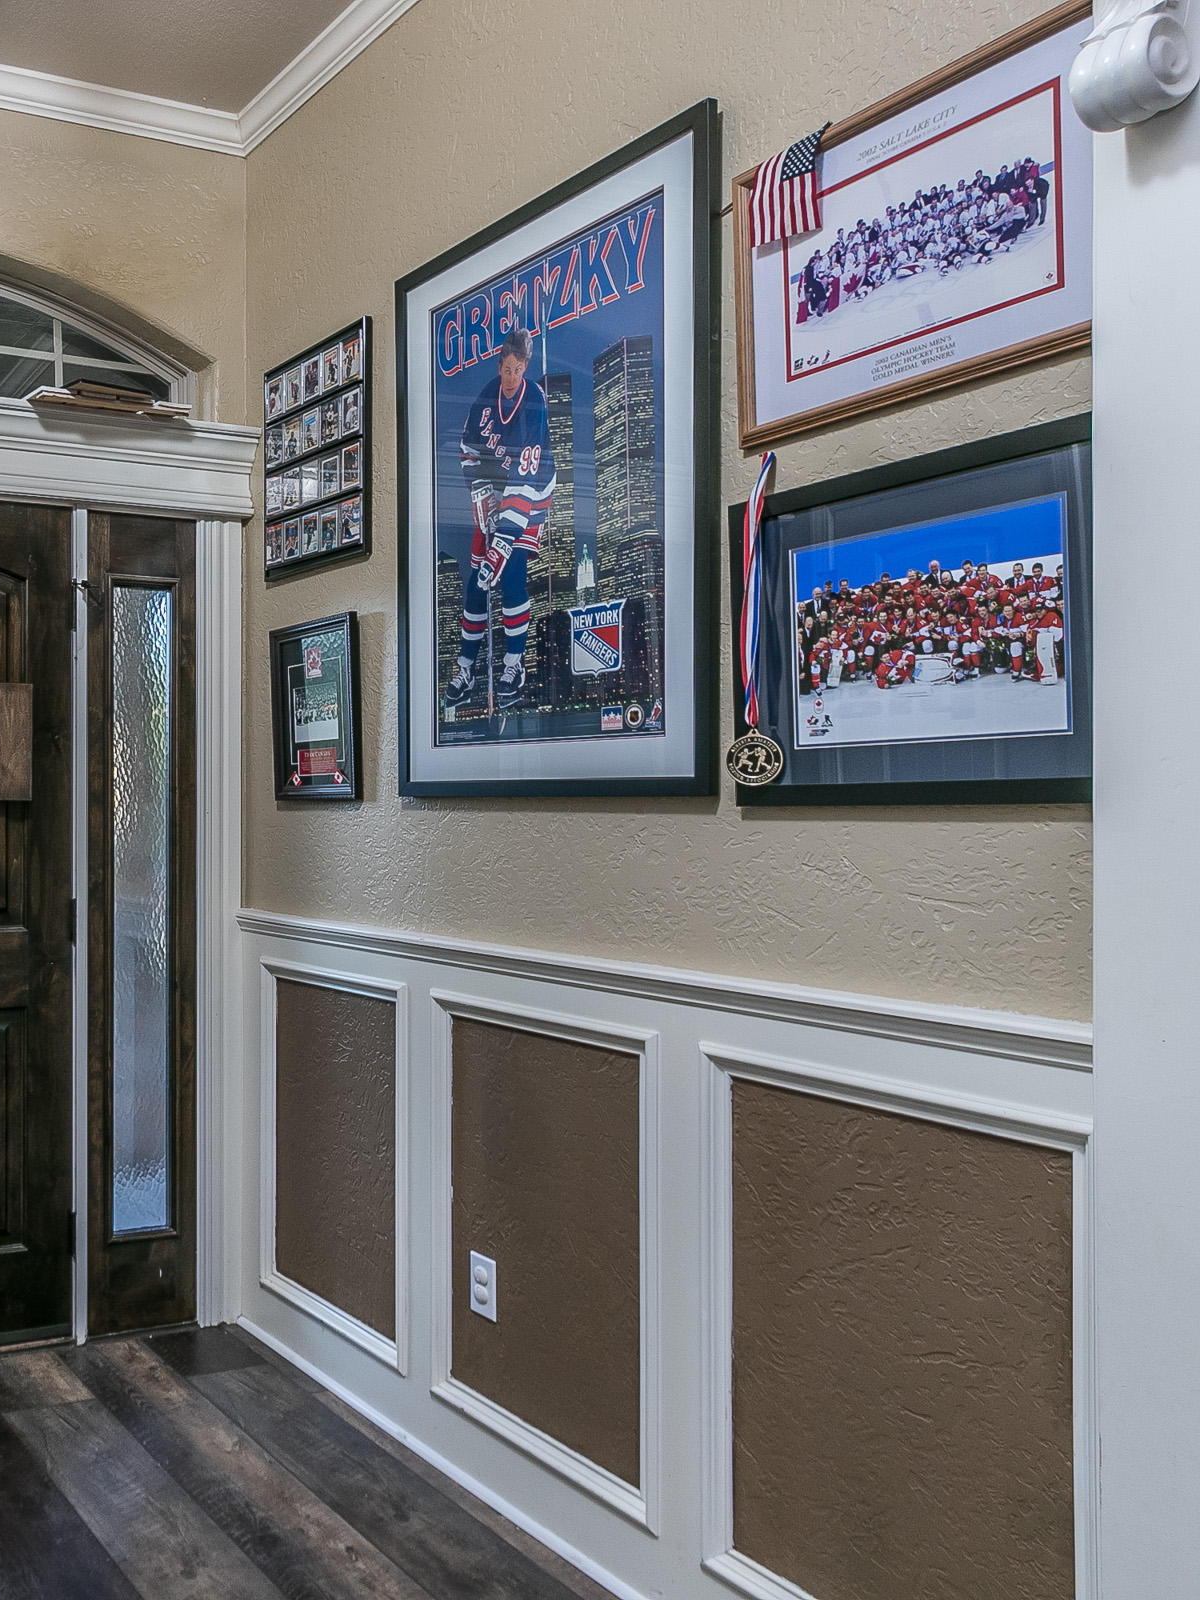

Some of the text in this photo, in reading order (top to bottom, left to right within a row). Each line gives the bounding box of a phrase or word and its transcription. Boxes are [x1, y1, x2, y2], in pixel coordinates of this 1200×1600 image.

[857, 104, 958, 161] 2002 SALT LAKE CITY
[438, 204, 656, 377] GRETZKY
[871, 342, 956, 375] OLYMPIC HOCKEY TEAM
[872, 350, 955, 382] GOLD MEDAL WINNERS
[875, 335, 953, 366] 2002 CANADIAN MEN'S
[518, 444, 541, 476] 99
[574, 609, 619, 629] NEW YORK
[579, 630, 618, 666] RANGERS
